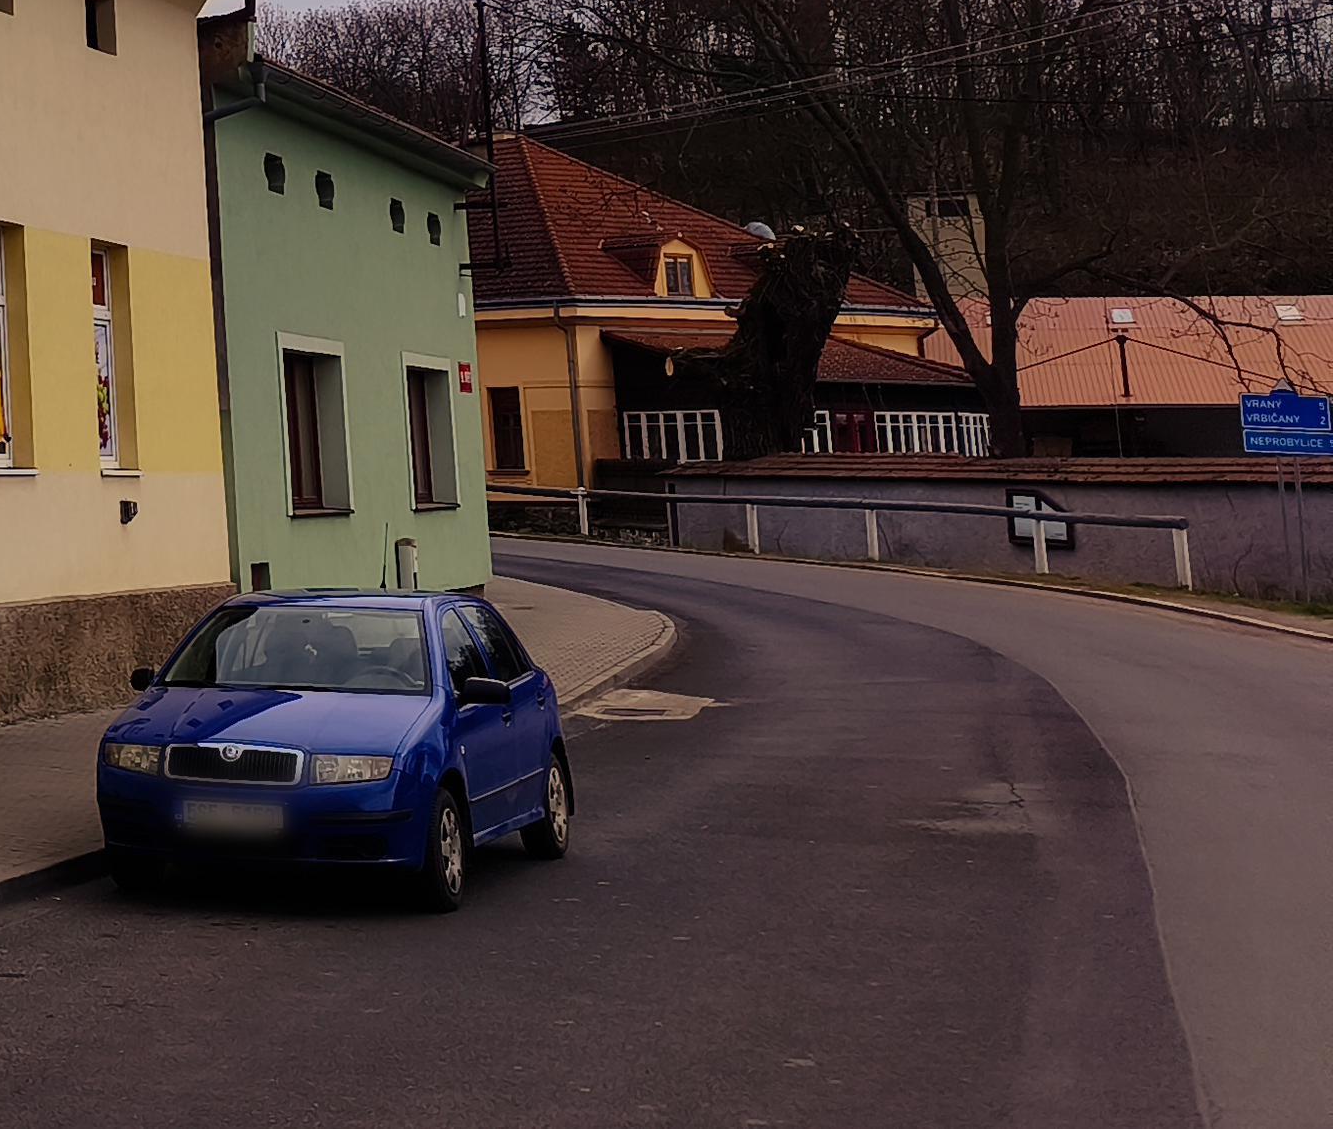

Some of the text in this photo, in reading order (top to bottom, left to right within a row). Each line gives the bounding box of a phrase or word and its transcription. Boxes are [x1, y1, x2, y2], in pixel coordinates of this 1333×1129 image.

[1246, 412, 1326, 425] VRBIČANY 2
[1250, 436, 1324, 448] NEPROBYLICE
